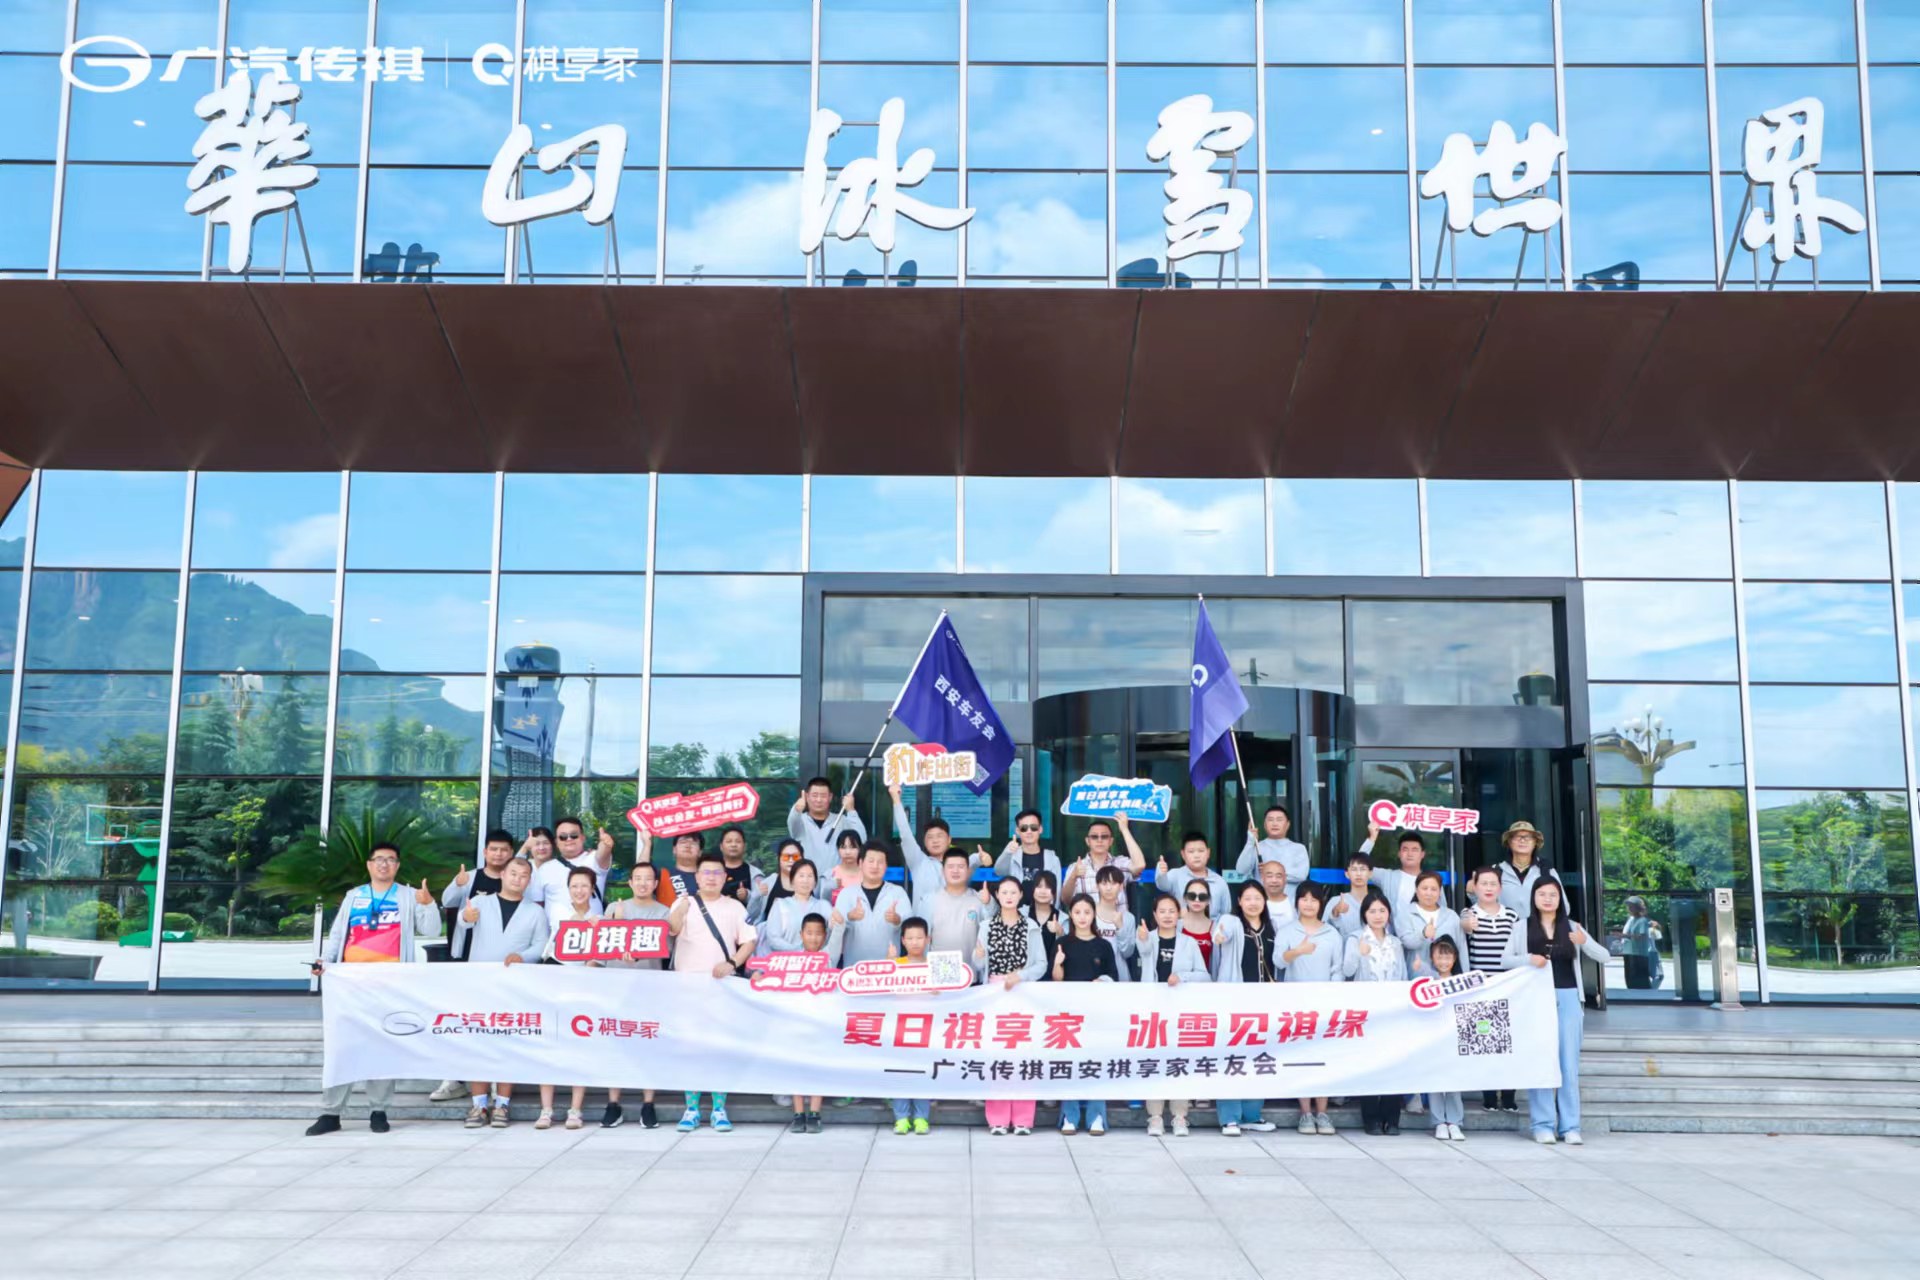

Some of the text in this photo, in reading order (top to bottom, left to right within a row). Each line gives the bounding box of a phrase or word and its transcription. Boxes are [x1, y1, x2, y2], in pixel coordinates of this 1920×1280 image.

[934, 674, 996, 741] 西安车友会
[1403, 806, 1477, 832] 祺享家
[562, 926, 662, 954] 创祺趣
[752, 955, 824, 972] 一祺智行
[783, 972, 839, 991] 更美好
[432, 1012, 542, 1028] 广汽传祺
[599, 1017, 660, 1039] 祺享家
[843, 1008, 1370, 1049] 夏日祺享家 冰雪见祺缘
[432, 1027, 542, 1036] GAC TRUMPCHI
